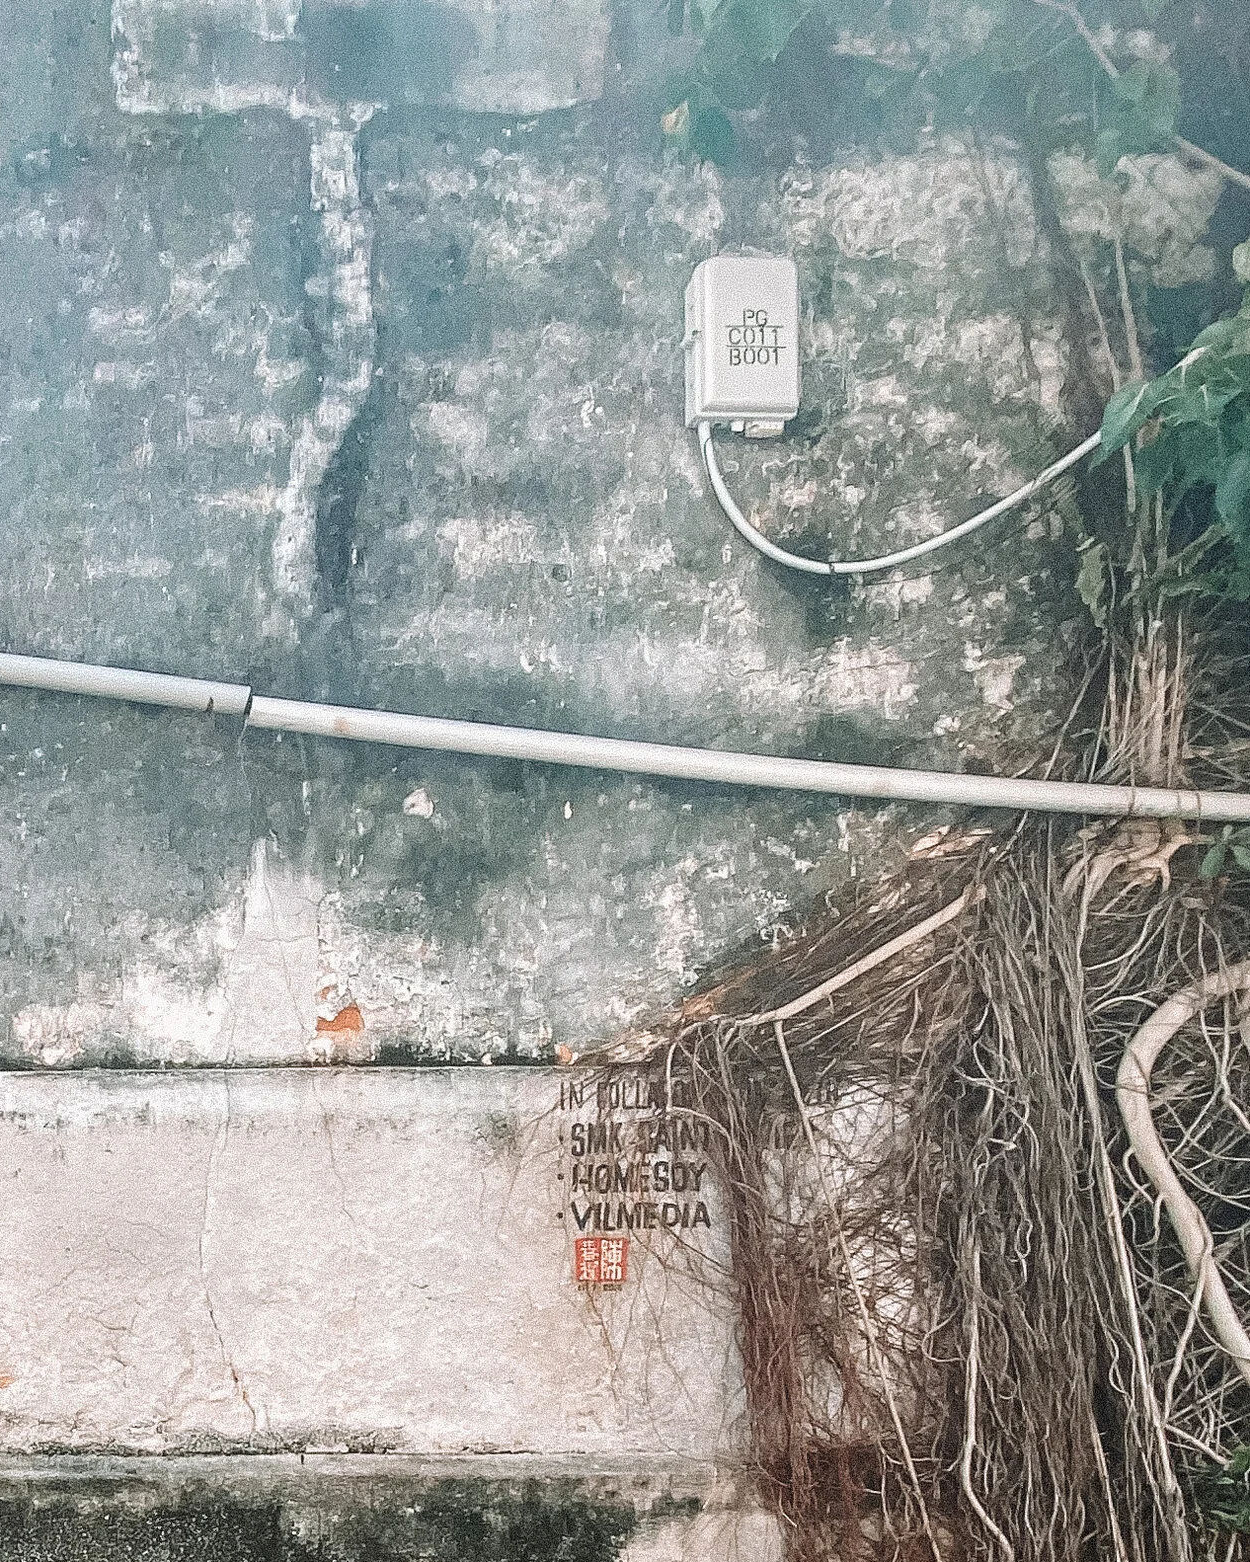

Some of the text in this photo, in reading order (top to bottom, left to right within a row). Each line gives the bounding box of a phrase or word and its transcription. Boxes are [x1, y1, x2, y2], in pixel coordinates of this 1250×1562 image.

[743, 309, 769, 327] PG
[560, 1081, 583, 1111] IN
[572, 1161, 708, 1194] HOMESOY
[570, 1201, 711, 1231] VILMEDIA
